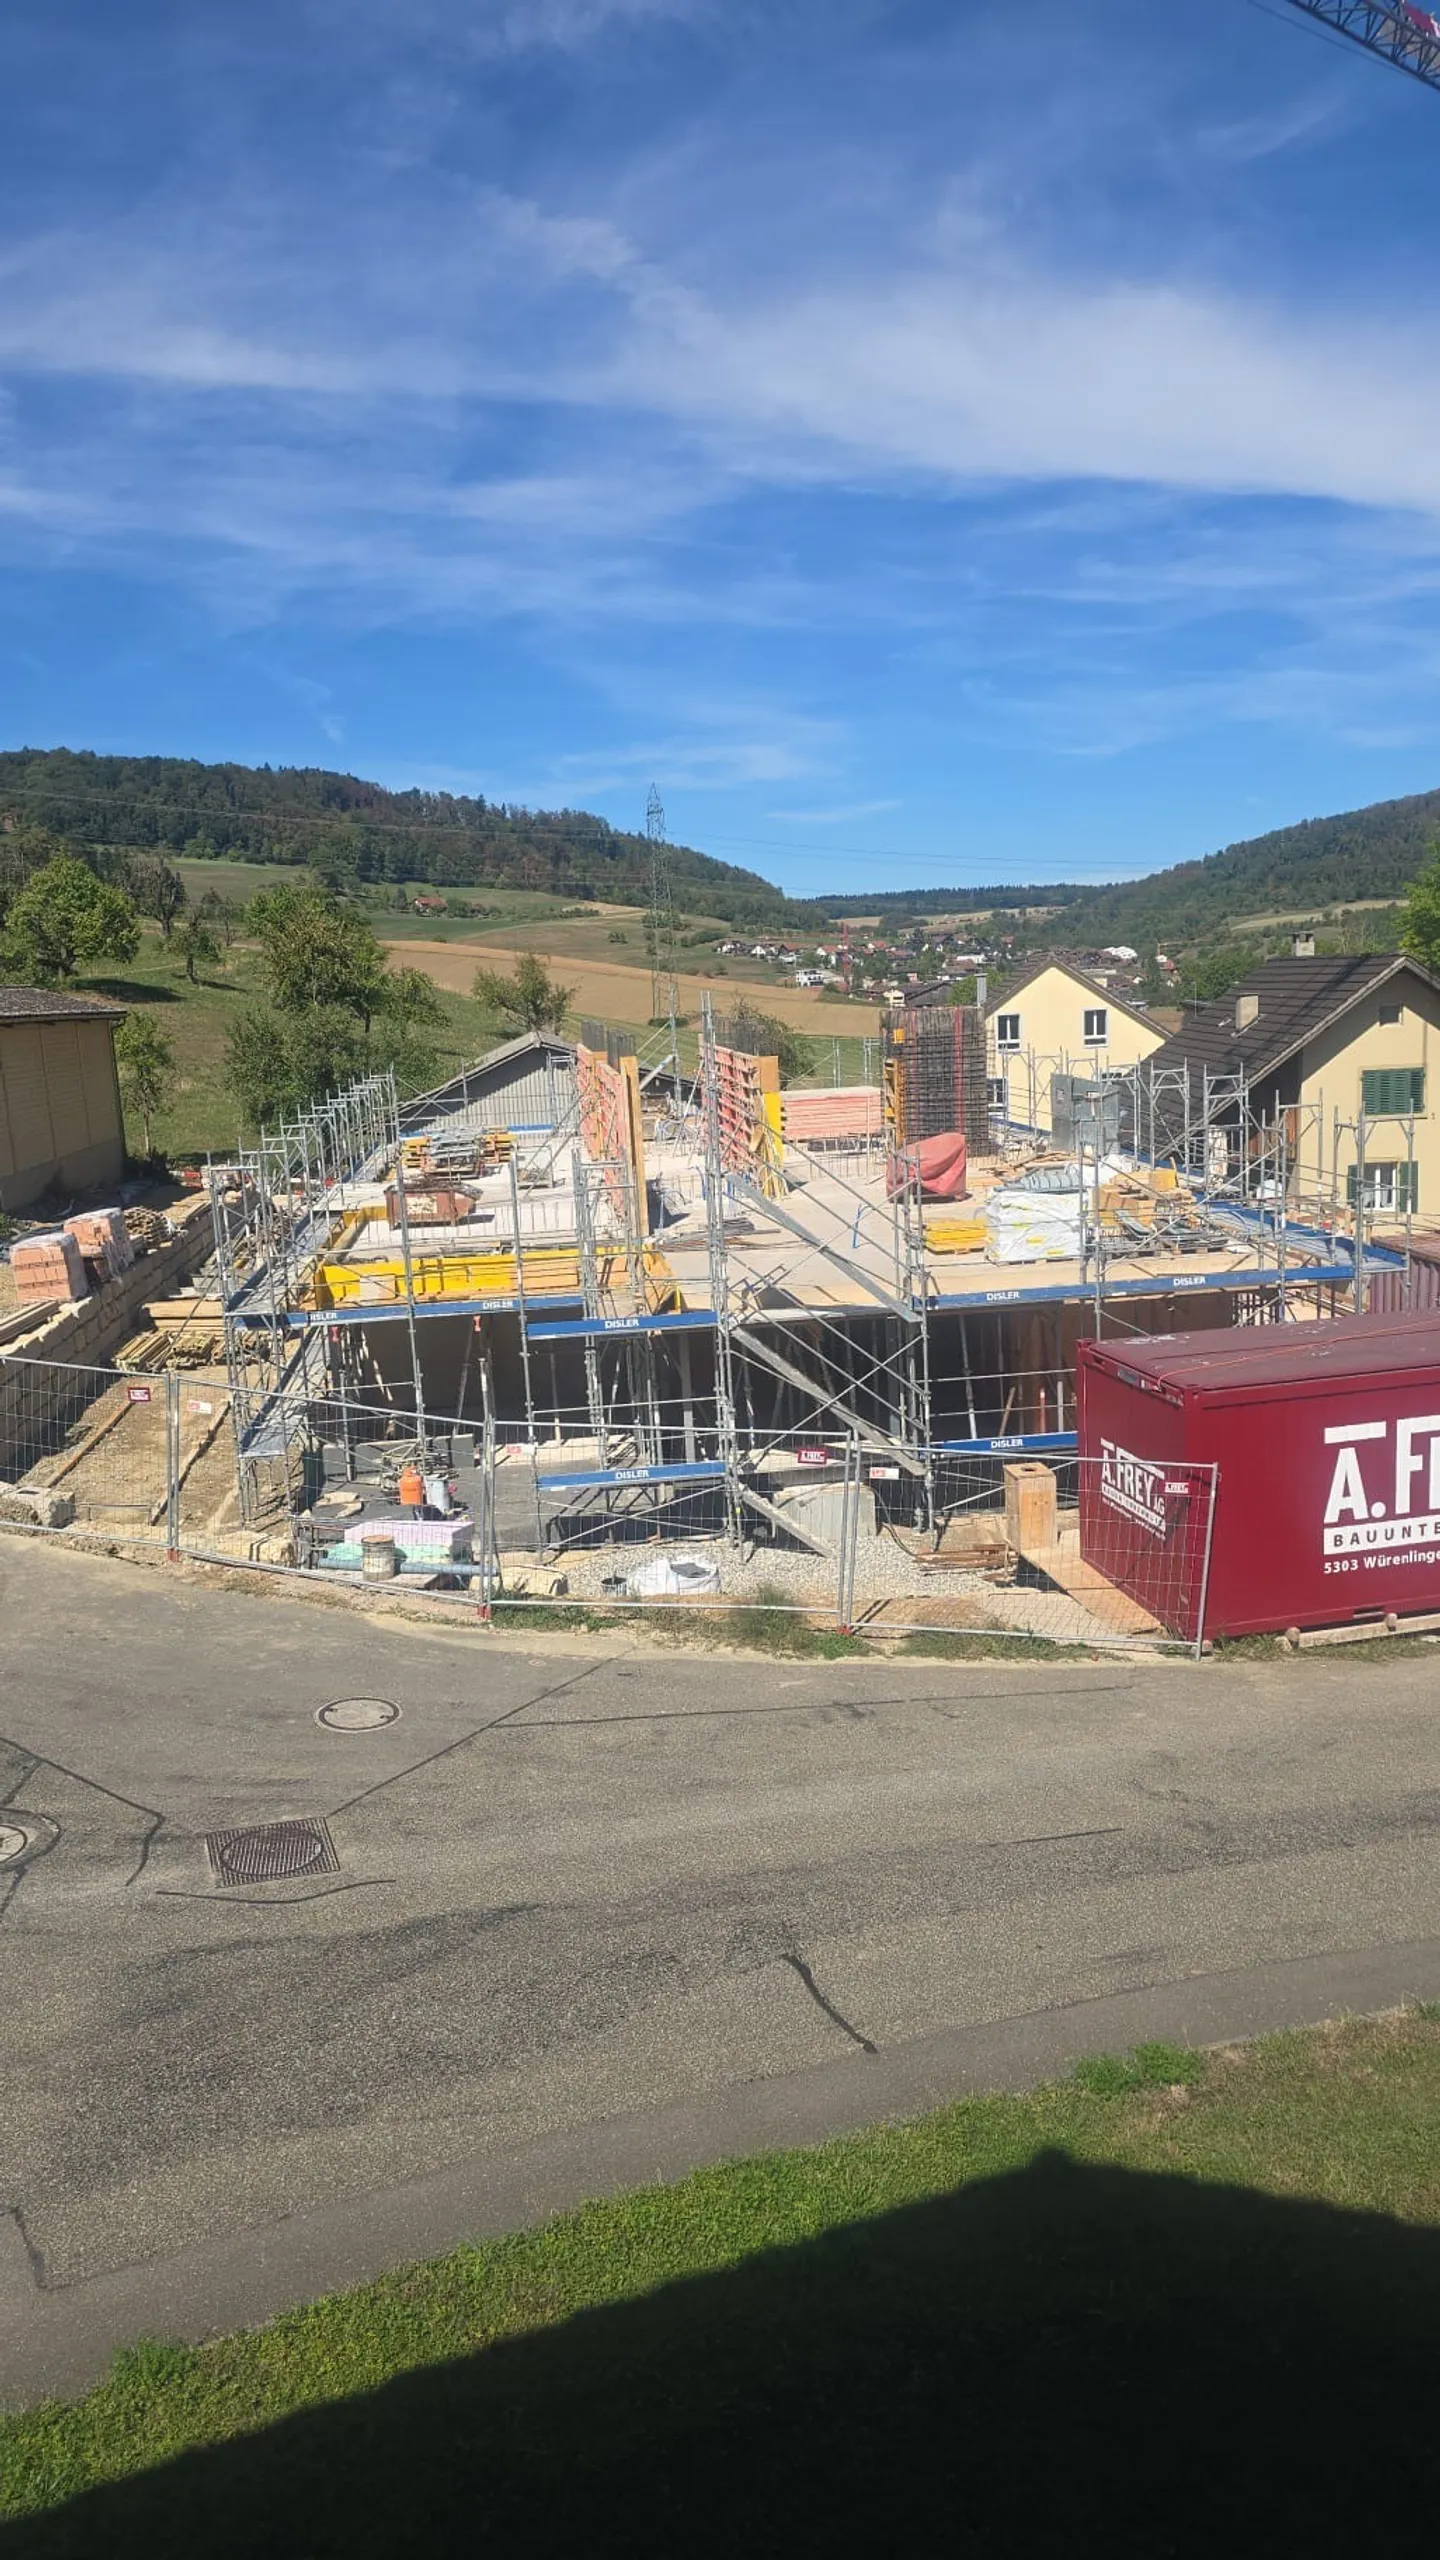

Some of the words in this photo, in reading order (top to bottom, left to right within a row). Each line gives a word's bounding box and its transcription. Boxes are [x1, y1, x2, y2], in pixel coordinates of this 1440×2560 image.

[1173, 1275, 1205, 1287] DISLER
[986, 1290, 1020, 1301] DISLER
[482, 1299, 513, 1310] DISLER
[604, 1318, 639, 1329] DISLER
[991, 1438, 1023, 1449] DISLER
[616, 1469, 649, 1480] DISLER
[1101, 1445, 1157, 1508] A.FREY
[1324, 1559, 1359, 1574] 5303
